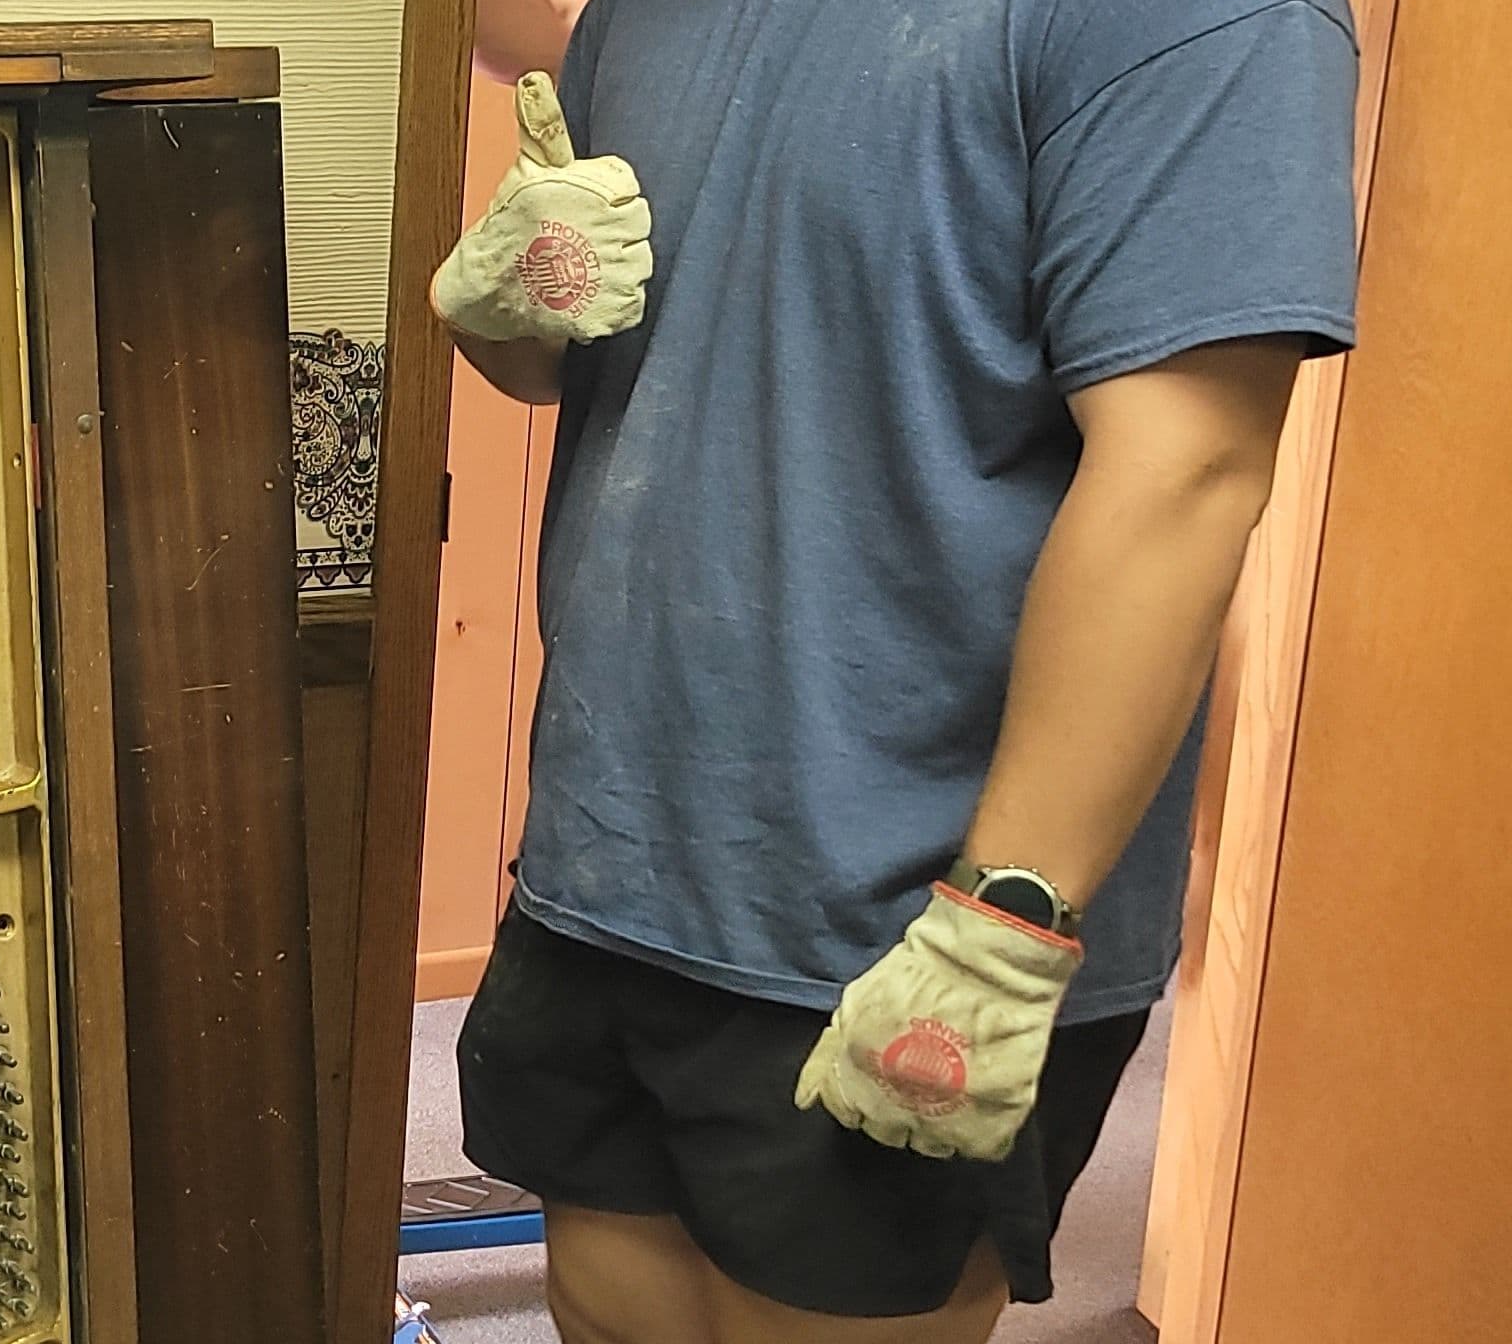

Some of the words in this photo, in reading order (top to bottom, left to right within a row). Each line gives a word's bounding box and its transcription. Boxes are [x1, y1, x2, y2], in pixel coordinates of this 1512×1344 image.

[541, 220, 600, 272] PROTECT
[551, 240, 585, 299] SAFETY
[514, 252, 538, 306] HANDS
[568, 277, 603, 319] YOUR
[909, 1017, 973, 1049] HANDS
